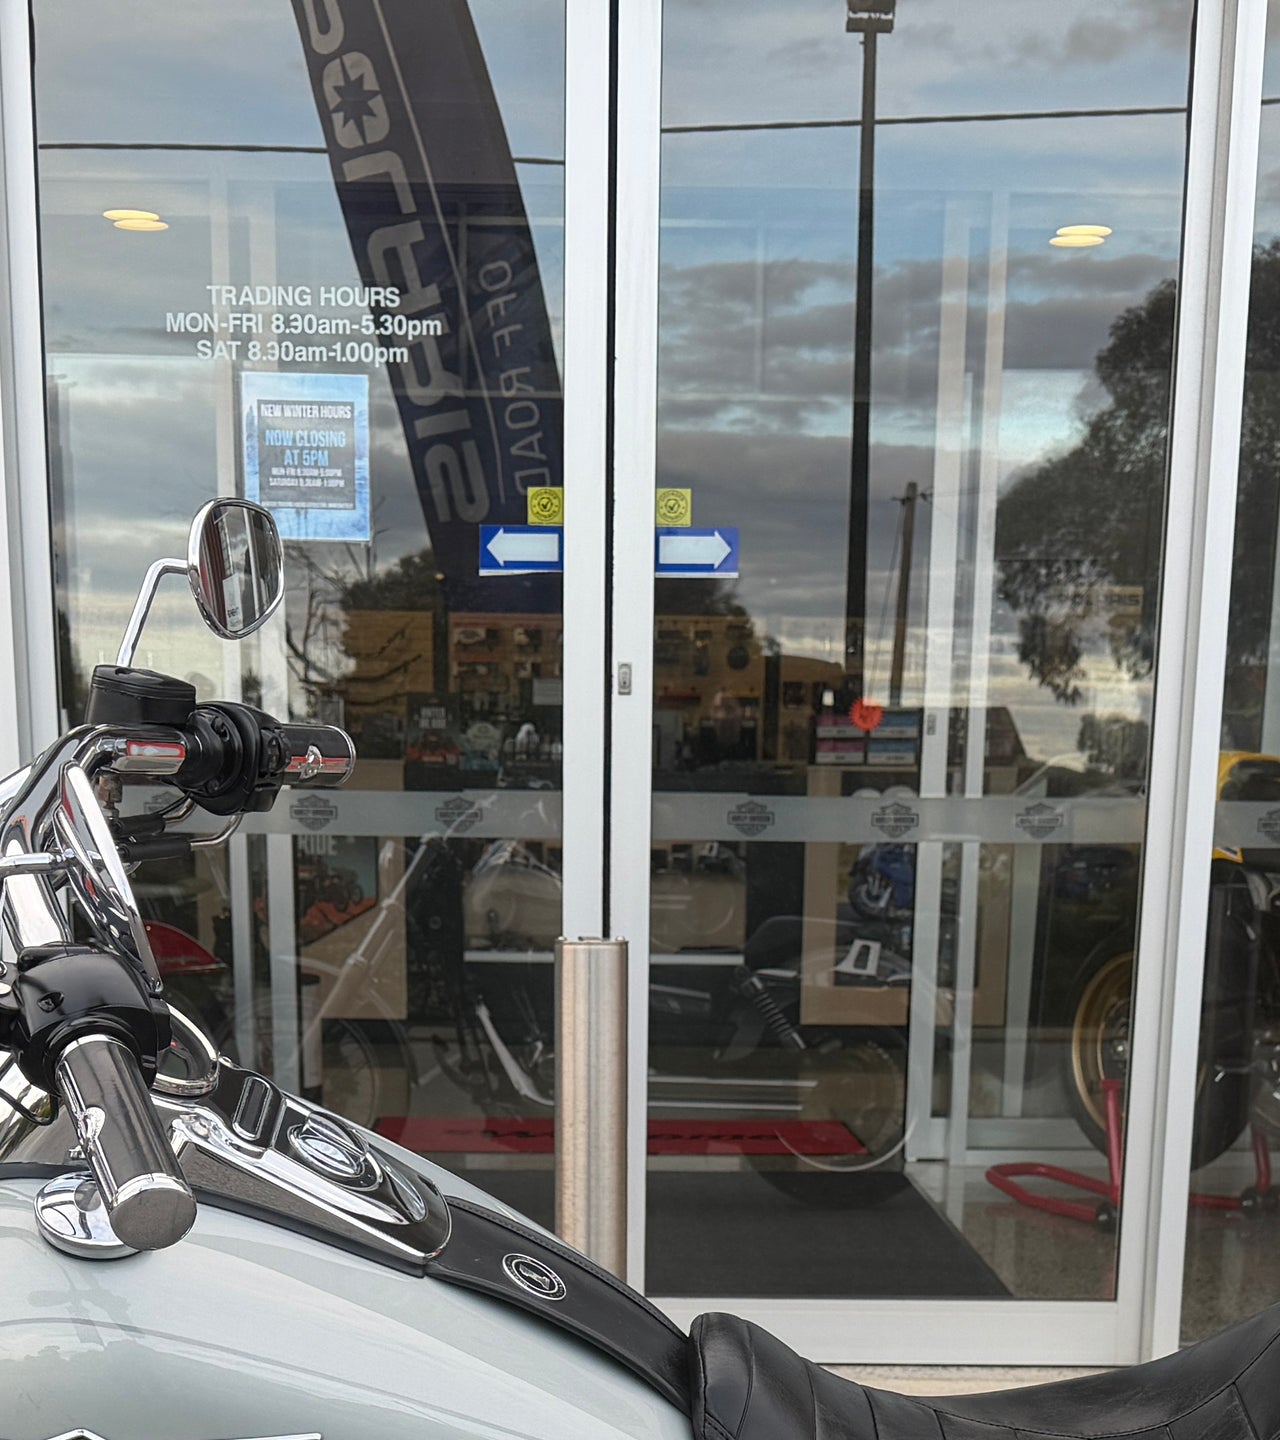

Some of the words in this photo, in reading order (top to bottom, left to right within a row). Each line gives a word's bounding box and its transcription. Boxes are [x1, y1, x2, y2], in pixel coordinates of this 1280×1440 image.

[207, 285, 312, 307] TRADING
[320, 287, 400, 308] HOURS
[165, 312, 262, 333] MON-FRI
[196, 340, 241, 361] SAT
[260, 404, 282, 417] NEW
[283, 405, 319, 418] WINTER
[320, 405, 352, 419] HOURS
[265, 429, 293, 446] NOW
[296, 430, 346, 447] CLOSING
[284, 449, 299, 466] AT
[303, 450, 329, 466] 5PM
